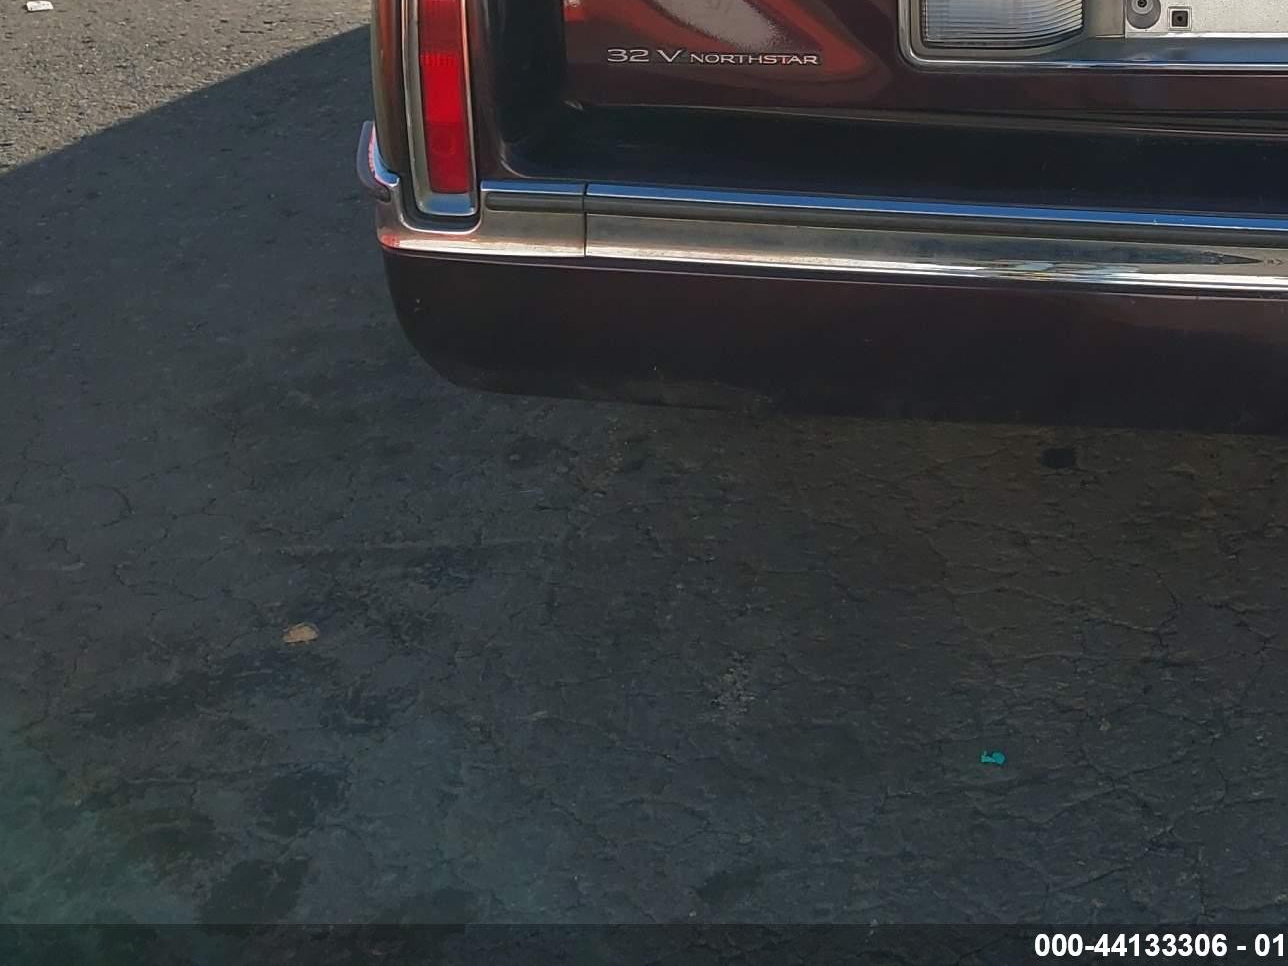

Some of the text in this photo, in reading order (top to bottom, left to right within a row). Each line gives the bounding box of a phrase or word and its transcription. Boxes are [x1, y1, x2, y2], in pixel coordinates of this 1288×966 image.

[607, 48, 819, 65] 32 V NORTHSTAR
